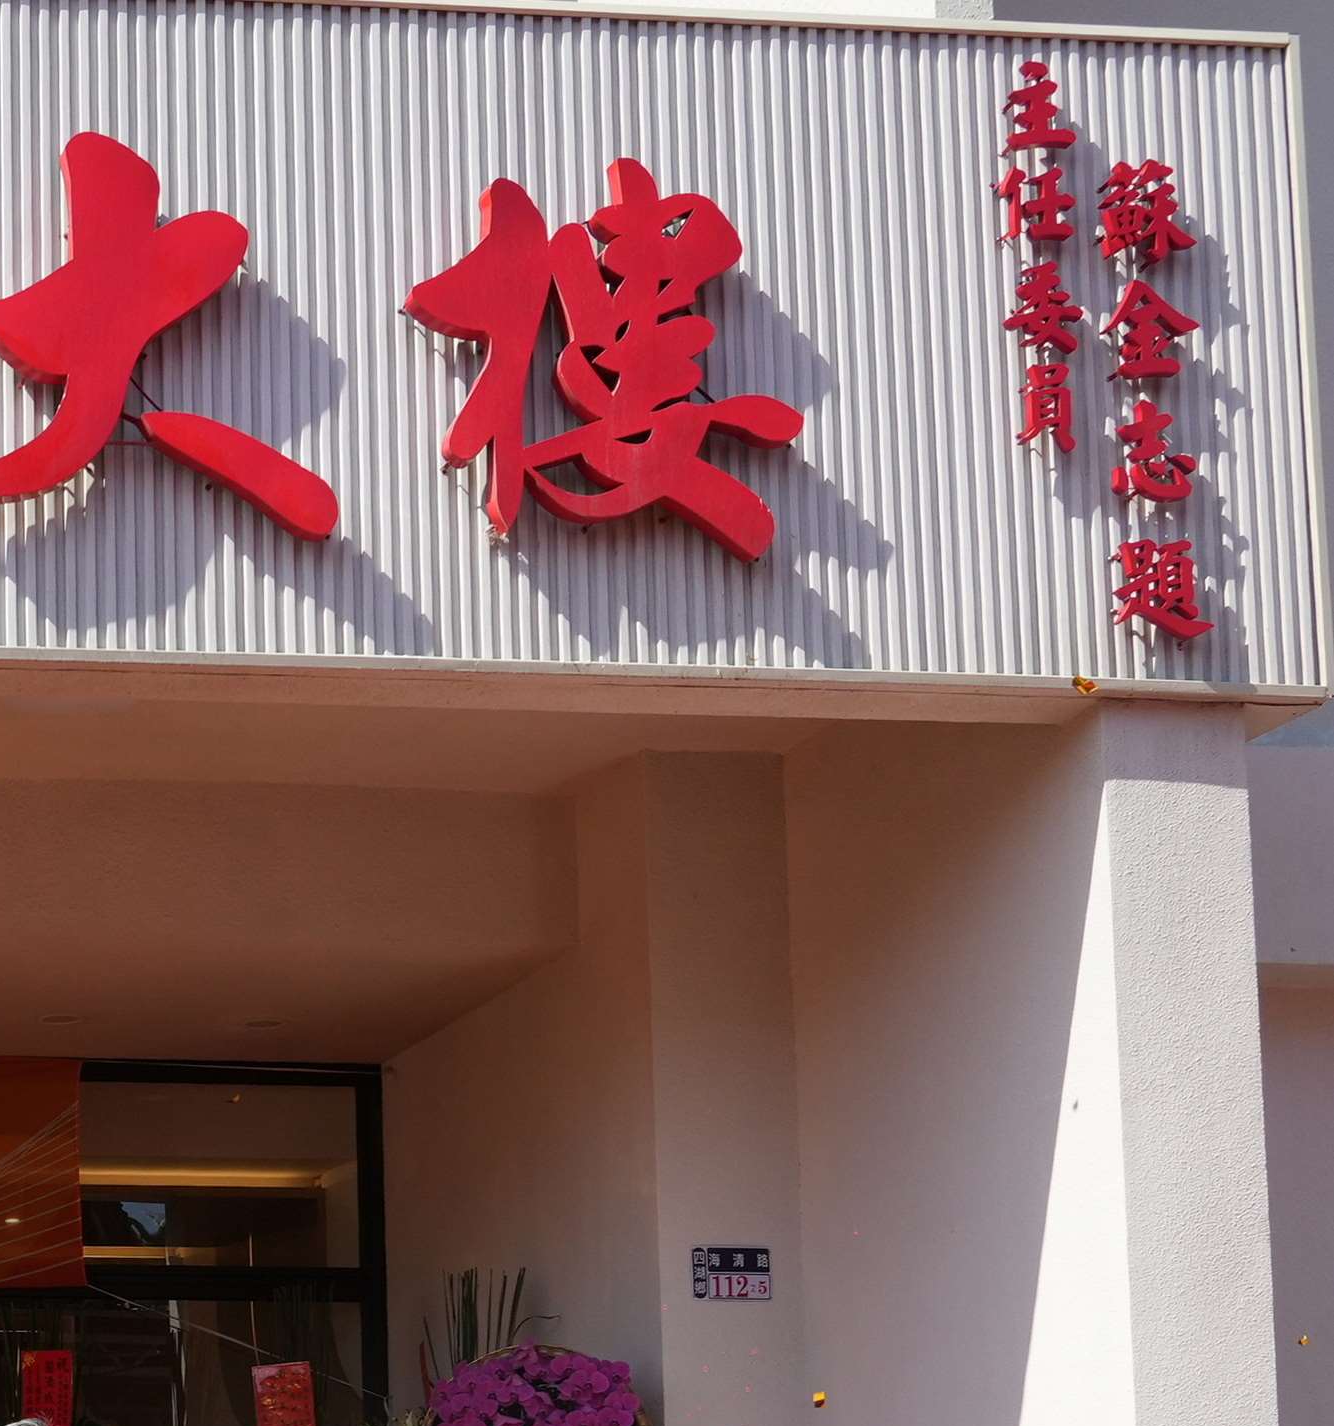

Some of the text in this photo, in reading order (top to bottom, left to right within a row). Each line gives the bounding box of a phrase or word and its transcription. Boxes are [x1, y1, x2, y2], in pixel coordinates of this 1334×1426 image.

[1001, 60, 1082, 453] 主任委員
[1099, 159, 1214, 639] 蘇金志題
